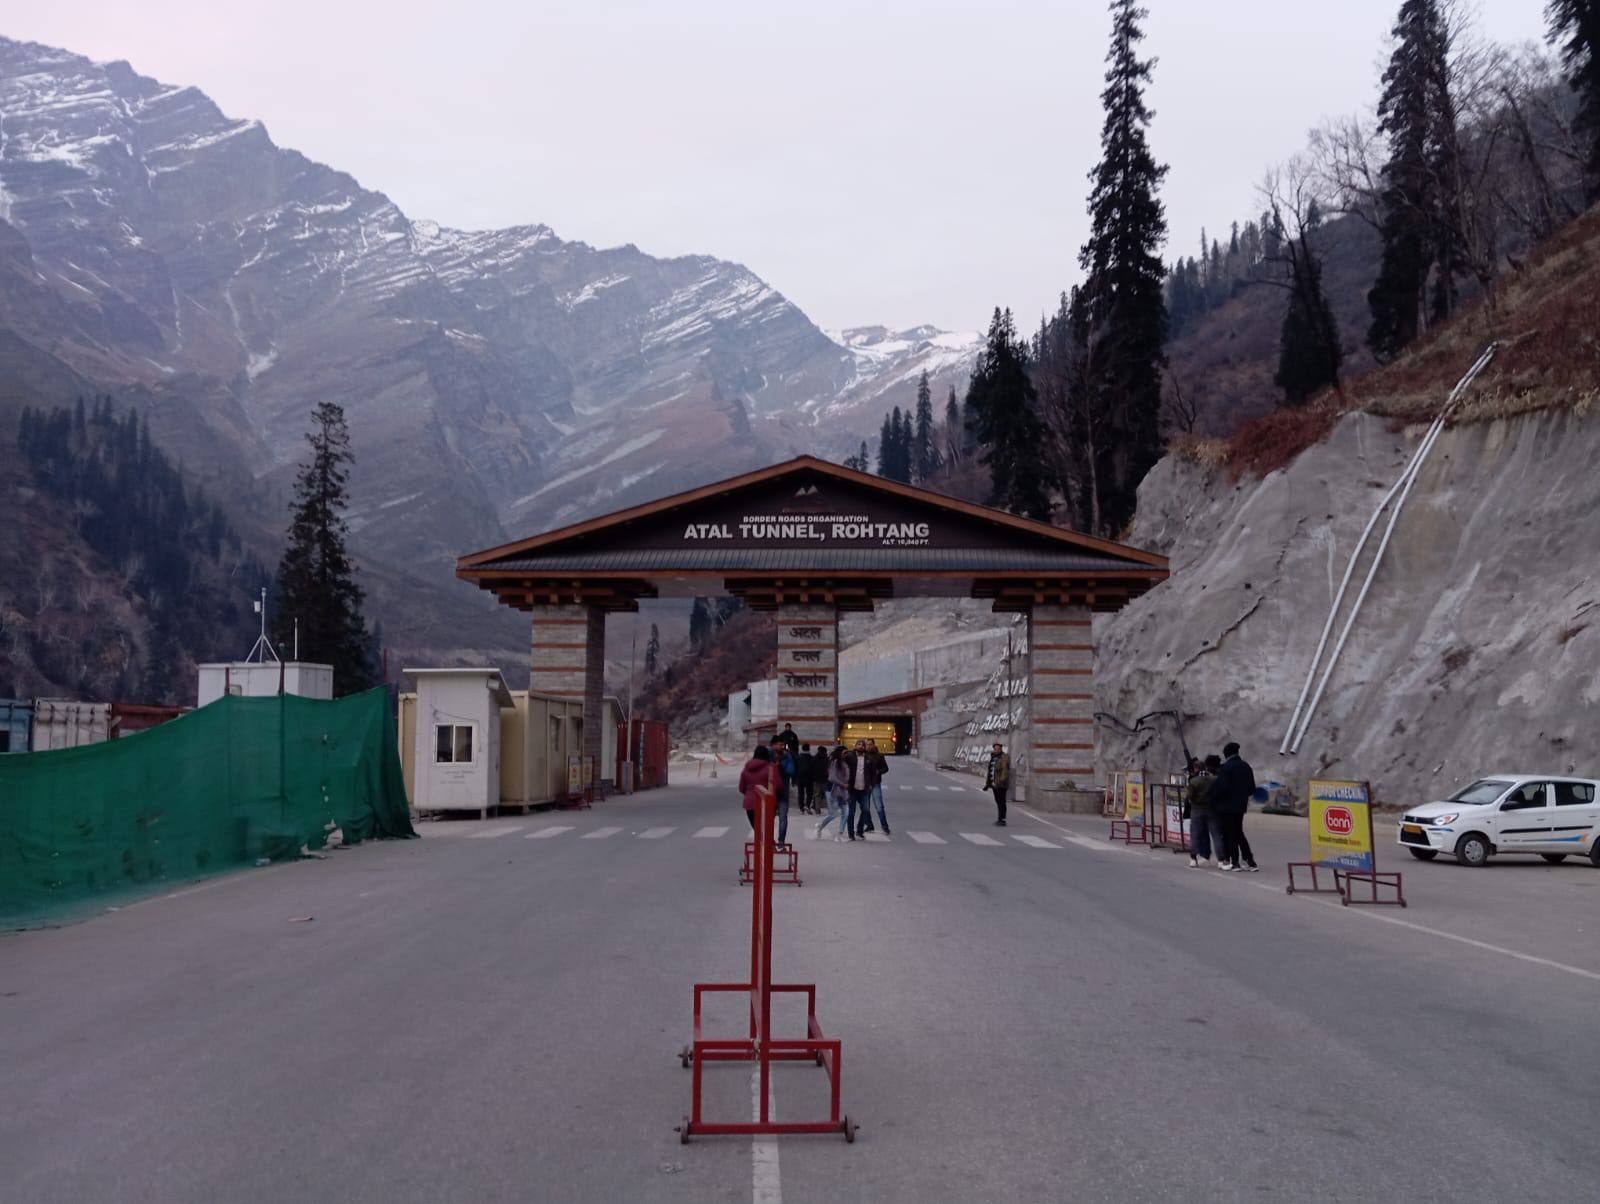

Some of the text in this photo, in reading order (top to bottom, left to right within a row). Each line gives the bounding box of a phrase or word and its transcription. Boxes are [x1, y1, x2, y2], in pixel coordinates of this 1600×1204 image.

[743, 515, 869, 523] BORDER ROADS ORGANISATION
[684, 522, 930, 541] ATAL TUNNEL, ROHTANG
[789, 627, 822, 640] अटल
[1327, 811, 1351, 828] bonn
